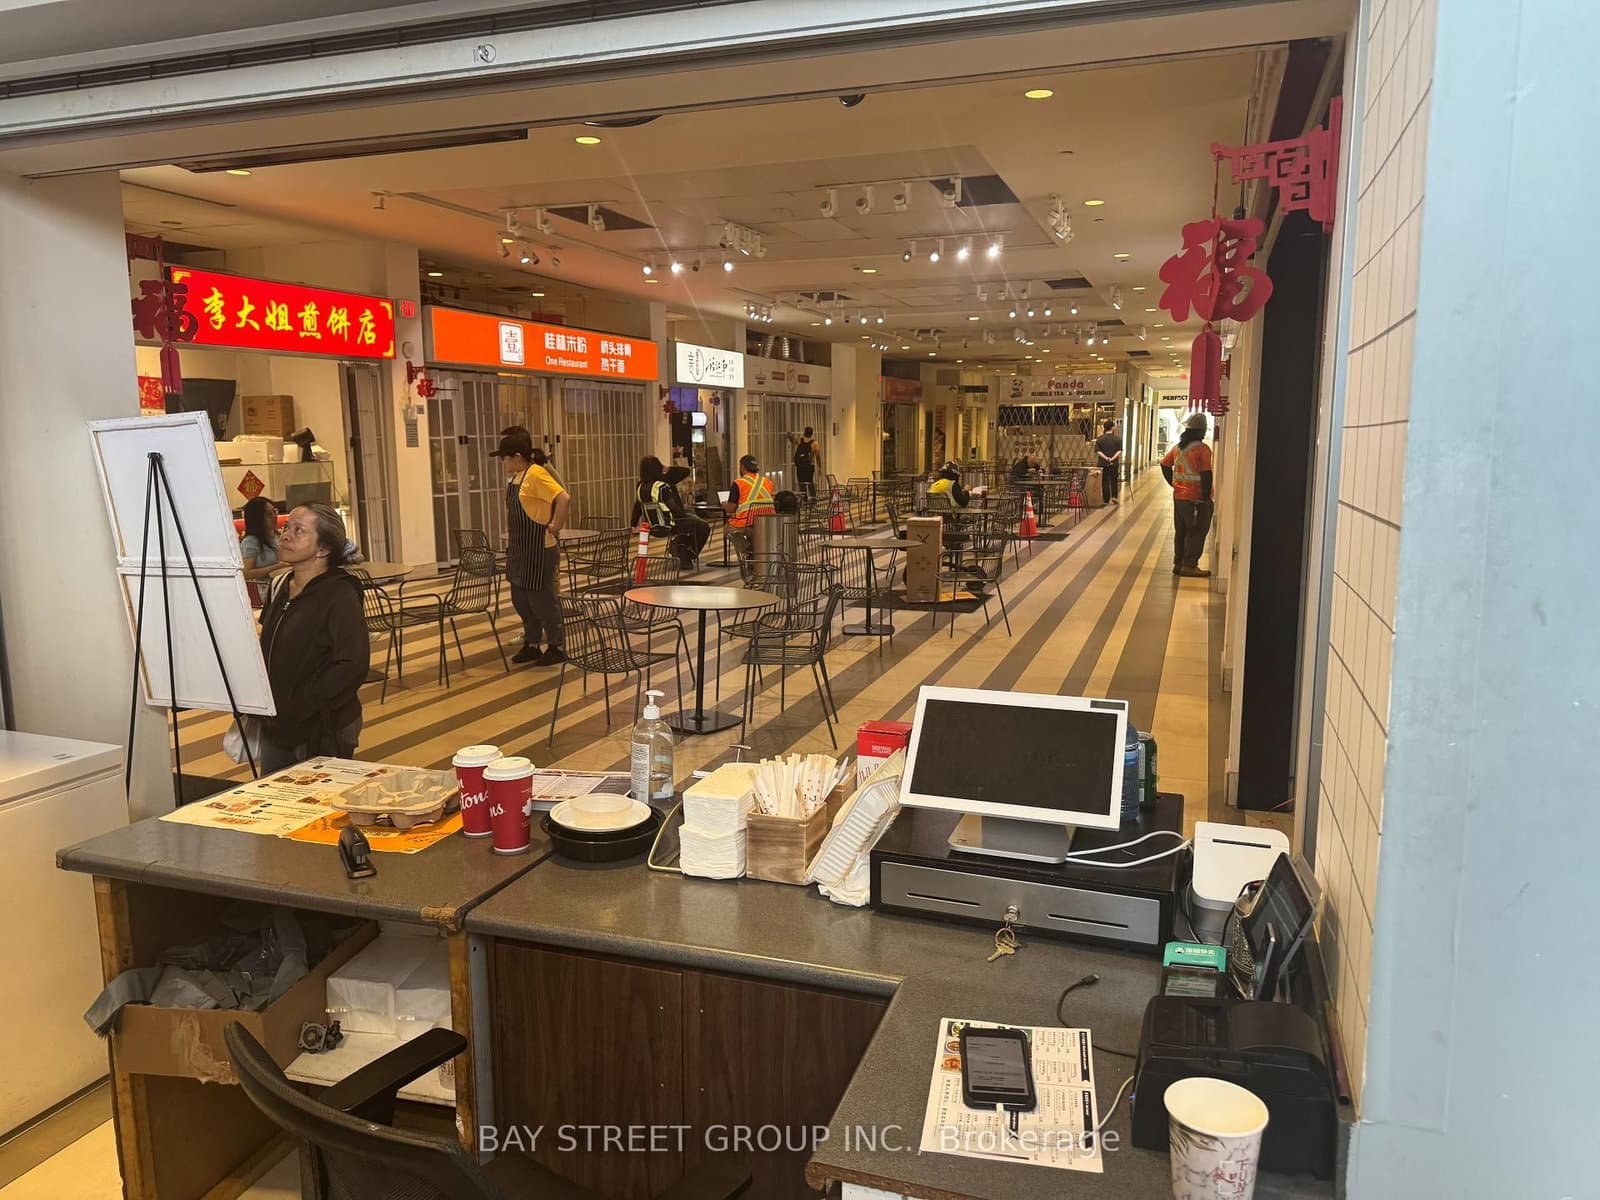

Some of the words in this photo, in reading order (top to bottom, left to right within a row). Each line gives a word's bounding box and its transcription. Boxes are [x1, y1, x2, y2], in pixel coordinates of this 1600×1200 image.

[202, 287, 377, 346] 李大姐煎饼店
[543, 331, 588, 354] 桂林米粉
[545, 354, 558, 367] One
[558, 357, 589, 369] Restaurant
[600, 357, 625, 374] 热干面
[1047, 379, 1085, 390] Panda
